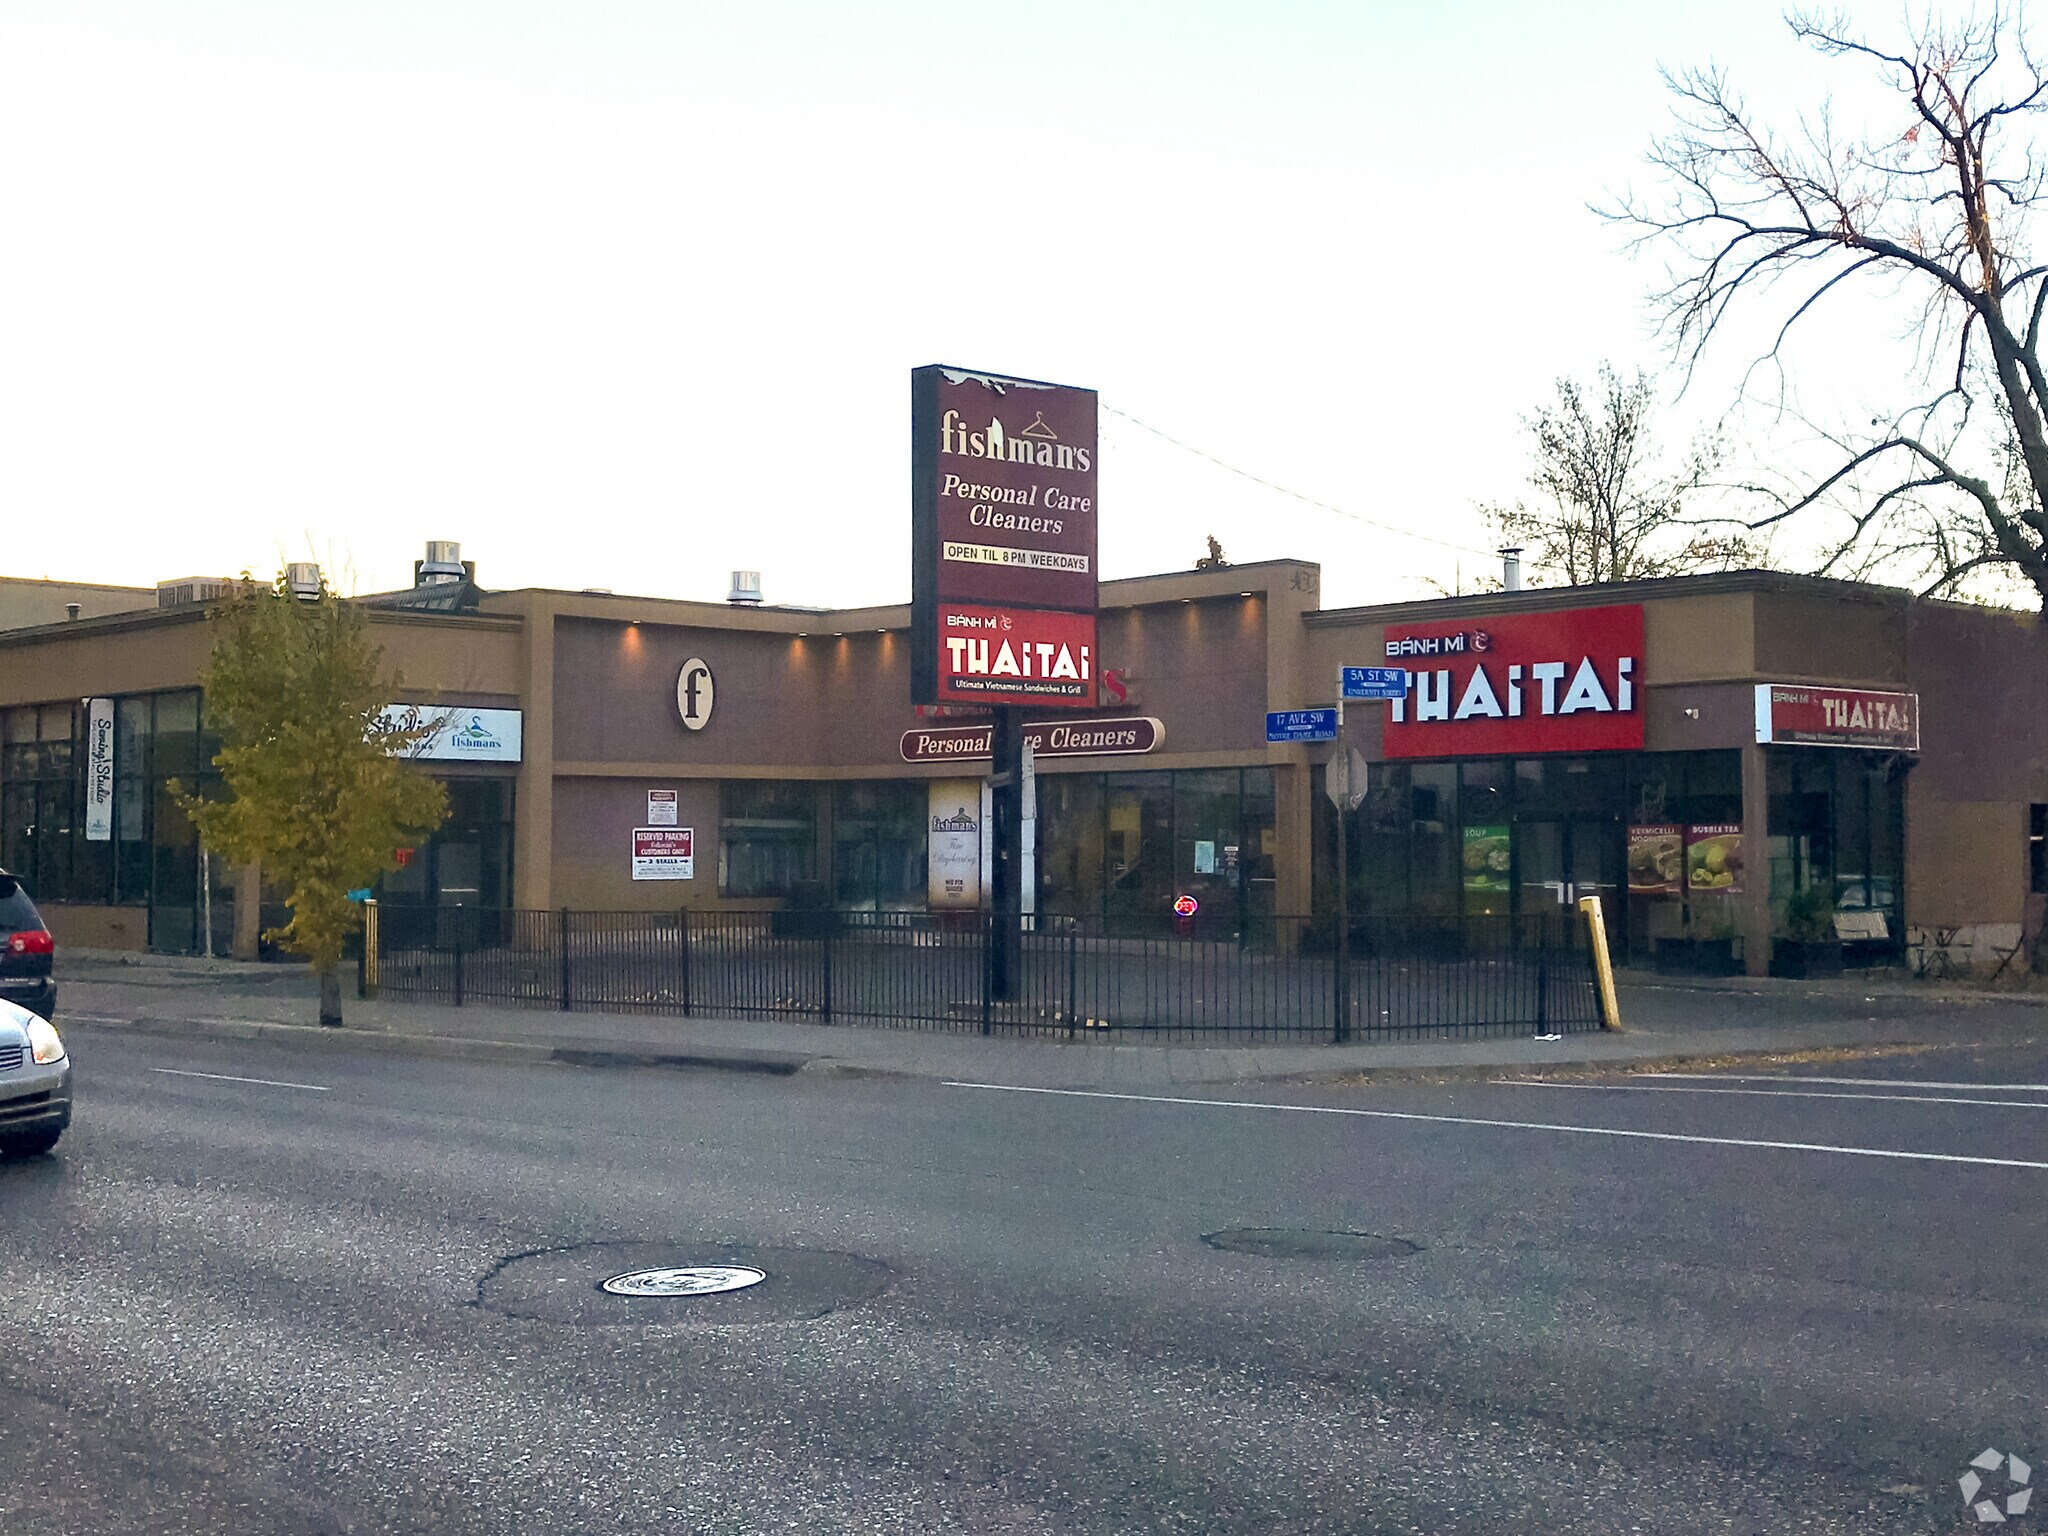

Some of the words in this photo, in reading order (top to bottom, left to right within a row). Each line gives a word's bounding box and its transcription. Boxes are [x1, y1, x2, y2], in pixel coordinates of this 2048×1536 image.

[941, 474, 1038, 506] Personal
[1044, 486, 1091, 512] Care
[969, 504, 1063, 534] Cleaners
[948, 545, 978, 559] OPEN
[982, 548, 998, 561] TIL
[1030, 553, 1086, 570] WEEKDAYS
[1385, 636, 1439, 656] BÁNH
[1444, 632, 1464, 652] MÌ
[955, 680, 984, 690] Ultimate
[985, 681, 1023, 691] Vietnamese
[1024, 683, 1060, 693] Sandwiches
[1067, 685, 1081, 694] Grill
[1350, 670, 1364, 681] 5A
[1368, 670, 1379, 681] ST
[1384, 670, 1399, 681] SW
[684, 667, 708, 719] f
[1276, 714, 1286, 725] 17
[1288, 712, 1307, 724] AVE
[1310, 711, 1324, 723] SW
[916, 731, 991, 754] Personal
[1050, 726, 1137, 749] Cleaners
[97, 764, 110, 805] Studio
[1465, 829, 1487, 837] SOUP
